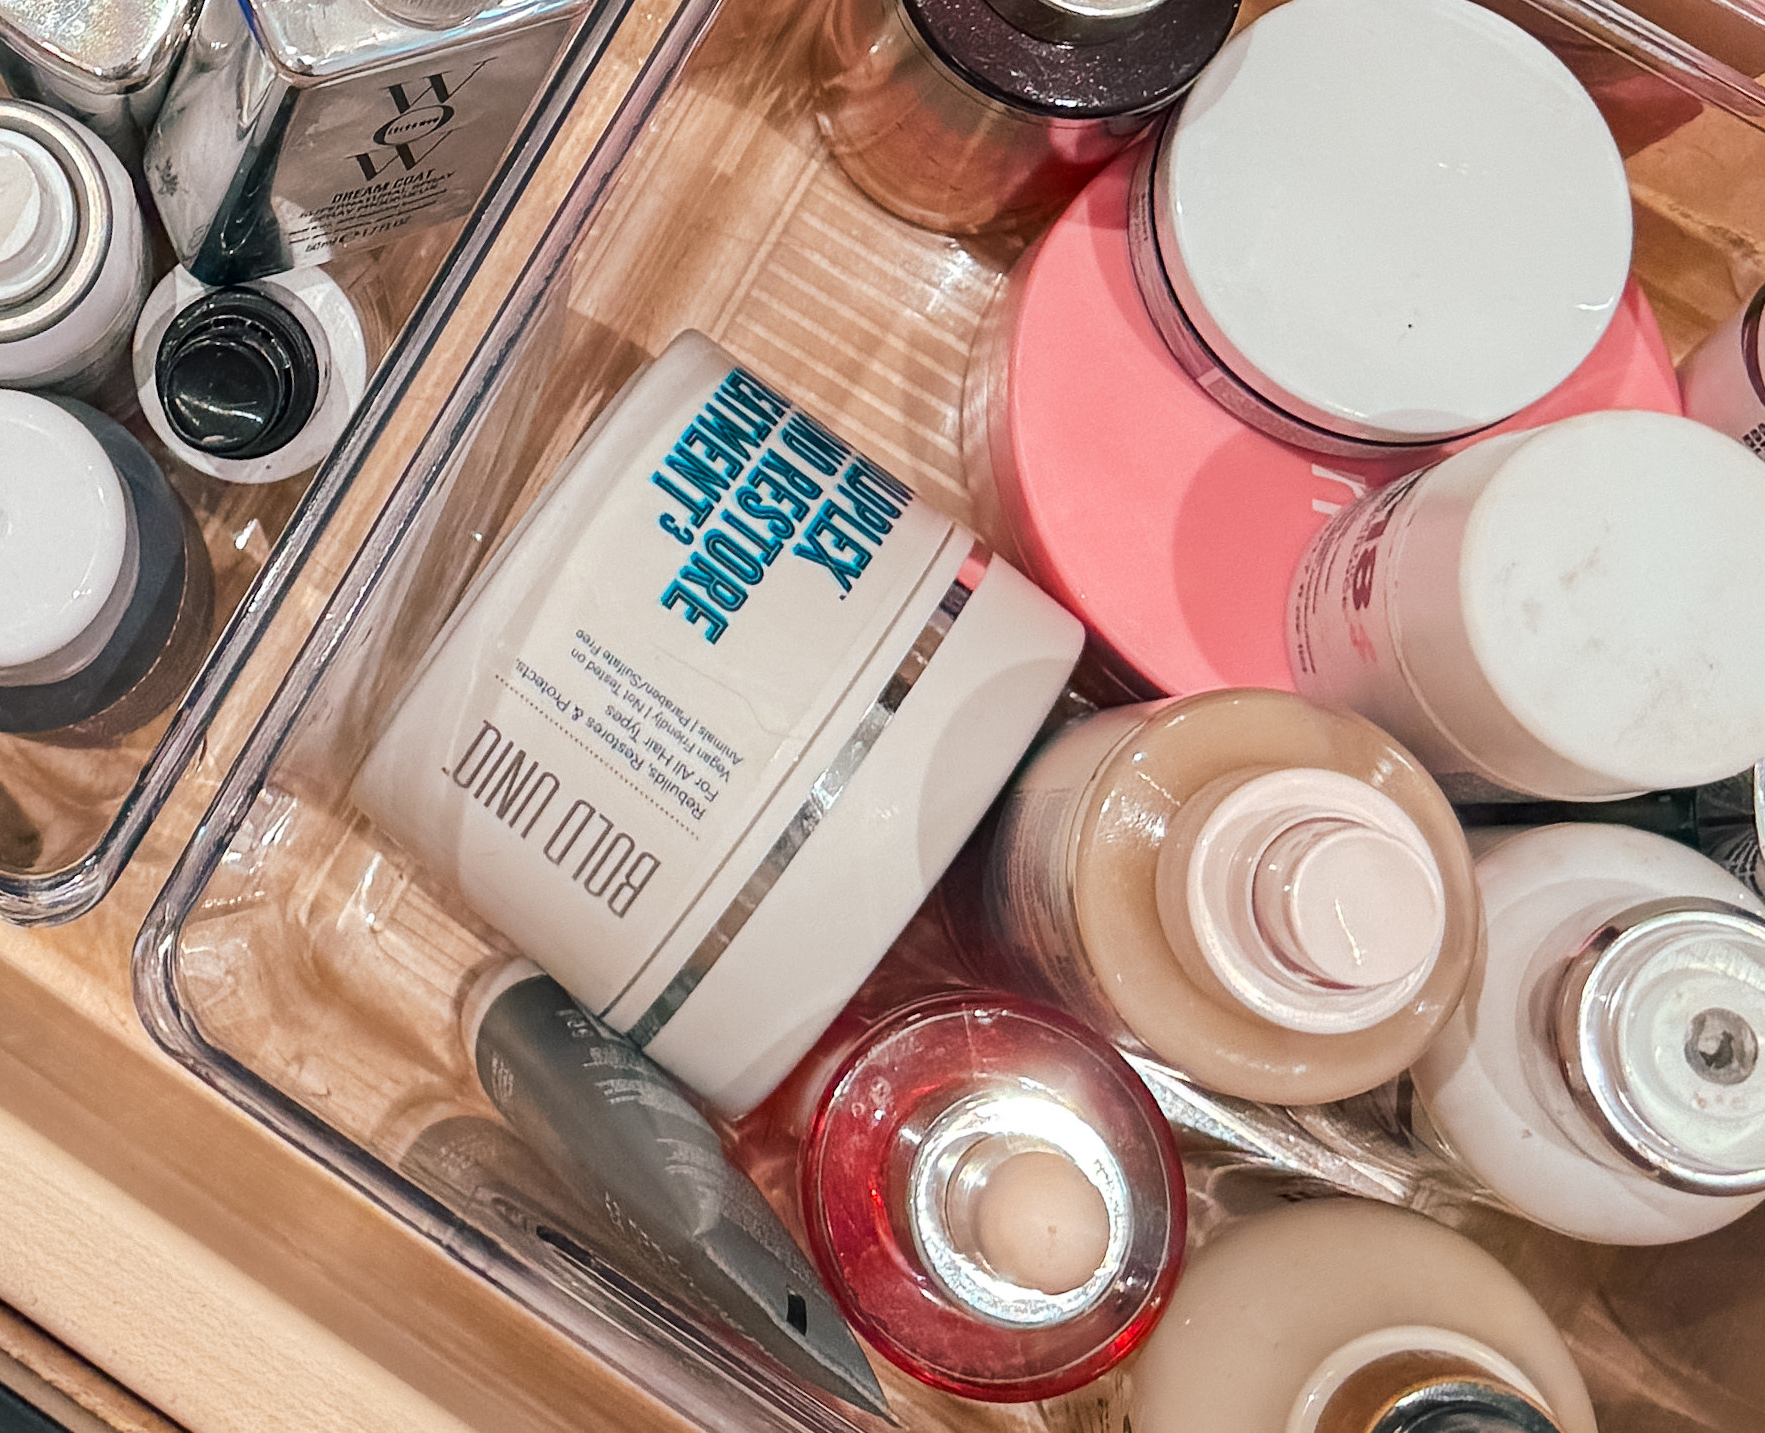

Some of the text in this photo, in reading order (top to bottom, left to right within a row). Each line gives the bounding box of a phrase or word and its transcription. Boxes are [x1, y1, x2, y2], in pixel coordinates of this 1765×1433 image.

[331, 170, 432, 203] DREAM COAT
[657, 448, 824, 644] RESTORE
[568, 646, 588, 665] on
[572, 627, 603, 656] Free
[583, 658, 624, 696] Tested
[598, 645, 693, 729] Paraben/Sulfate
[619, 688, 647, 714] Not
[508, 654, 709, 821] Rebuilds, Restores & Protects.
[600, 699, 720, 803] For All Hair Types
[647, 708, 698, 755] Friendly
[694, 723, 744, 768] Animals
[692, 743, 735, 784] Vegan
[539, 795, 662, 919] BOLD
